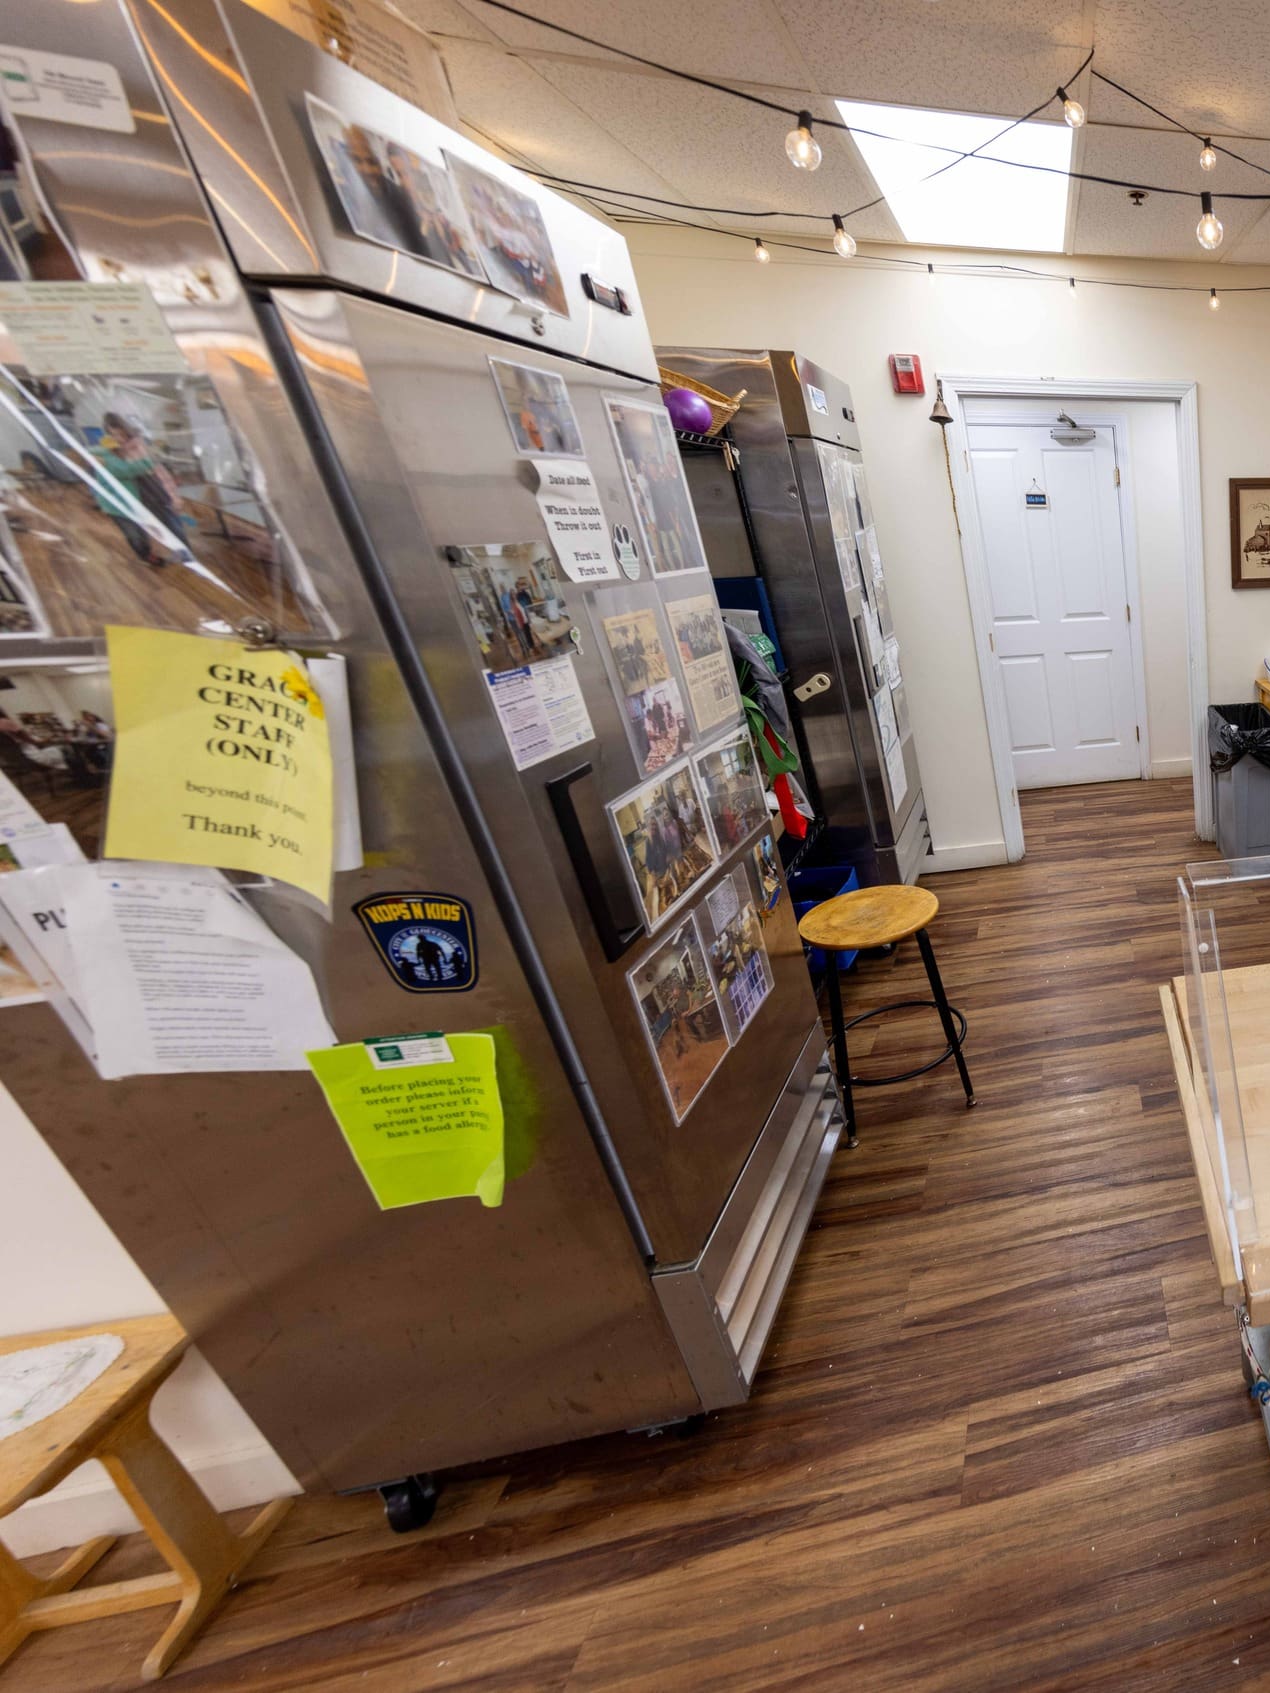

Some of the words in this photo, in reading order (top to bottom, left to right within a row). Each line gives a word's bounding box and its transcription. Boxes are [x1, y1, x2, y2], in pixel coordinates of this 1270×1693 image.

[548, 475, 565, 486] Date
[567, 476, 575, 486] all
[545, 505, 569, 515] When
[570, 506, 578, 515] in
[579, 505, 601, 516] doubt
[555, 521, 579, 531] Throw
[581, 521, 588, 530] it
[589, 521, 602, 531] out
[573, 552, 592, 561] First
[593, 552, 601, 561] in
[578, 567, 596, 576] First
[597, 567, 609, 575] out
[208, 664, 304, 703] GRAC
[197, 686, 306, 731] CENTER
[213, 713, 296, 748] STAFF
[206, 737, 299, 777] (ONLY)
[185, 780, 251, 801] beyond
[254, 793, 280, 809] this
[182, 813, 266, 841] Thank
[32, 908, 67, 932] PL
[364, 903, 412, 924] KOPS
[411, 903, 425, 920] N
[424, 902, 461, 922] KIDS
[360, 1083, 404, 1095] Before
[407, 1077, 456, 1091] placing
[365, 1095, 402, 1107] order
[406, 1090, 446, 1103] please
[385, 1105, 416, 1118] your
[419, 1099, 459, 1111] server
[373, 1117, 419, 1131] person
[421, 1115, 434, 1123] in
[437, 1110, 466, 1122] your
[386, 1129, 410, 1139] has
[423, 1122, 452, 1134] food
